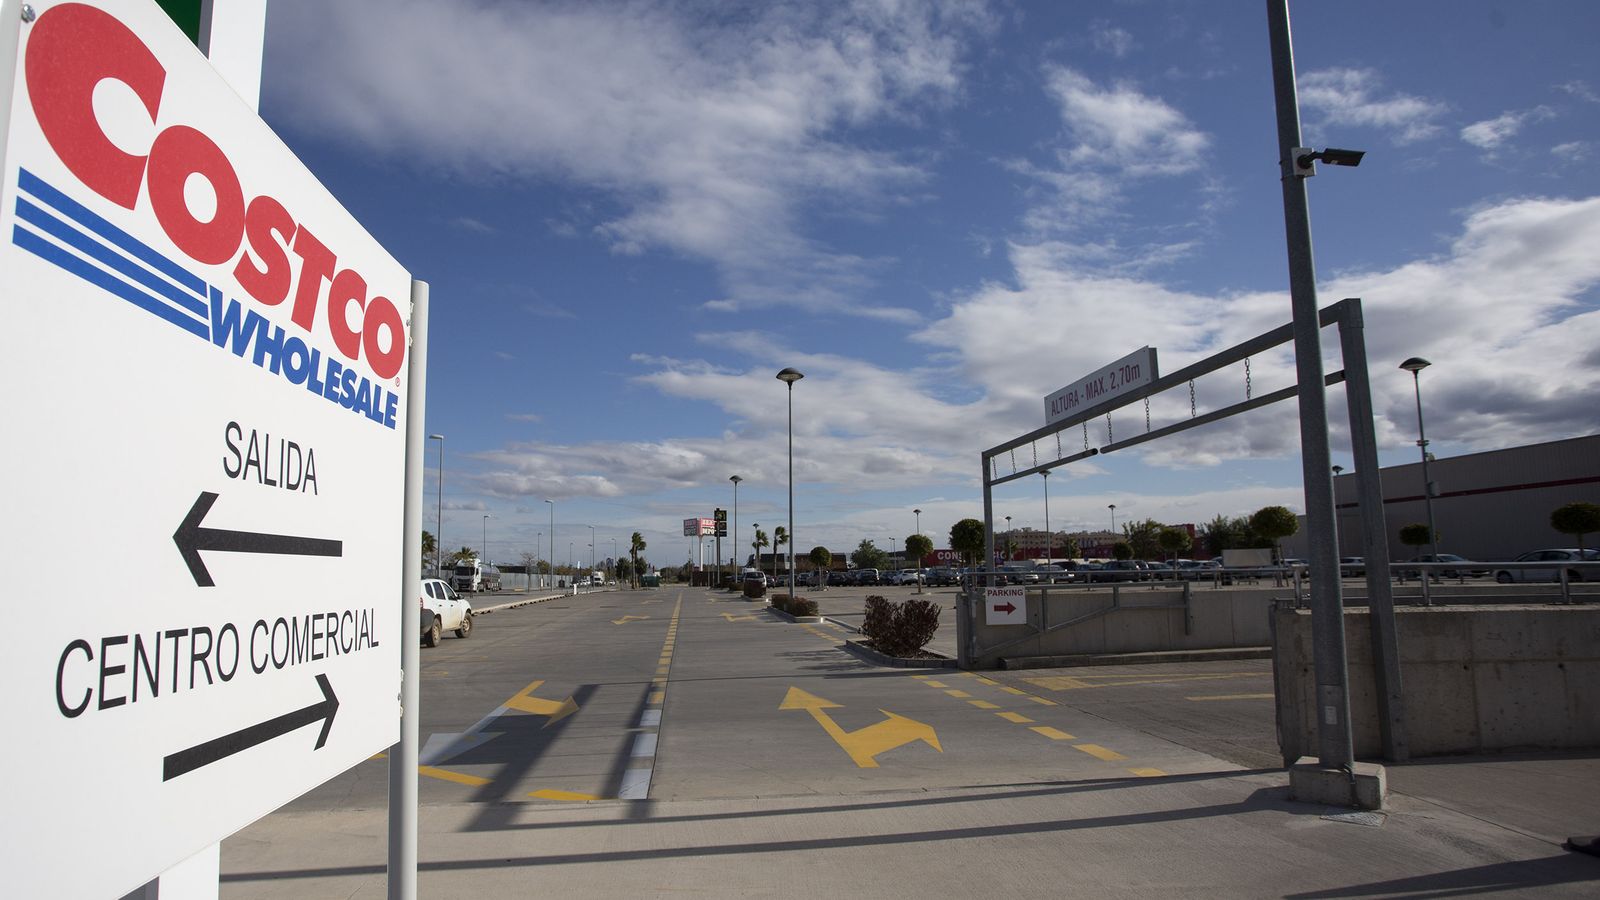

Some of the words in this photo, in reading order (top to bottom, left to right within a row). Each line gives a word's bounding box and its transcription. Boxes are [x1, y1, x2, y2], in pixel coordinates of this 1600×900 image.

[25, 2, 405, 380] COSTCO
[209, 284, 398, 430] WHOLESALE
[1051, 389, 1080, 416] ALTURA
[1085, 376, 1108, 400] MAX.
[1110, 363, 1140, 390] 2,70m
[223, 421, 318, 495] SALIDA
[987, 589, 1024, 597] PARKING
[56, 622, 239, 719] CENTRO
[250, 608, 379, 675] COMERCIAL
